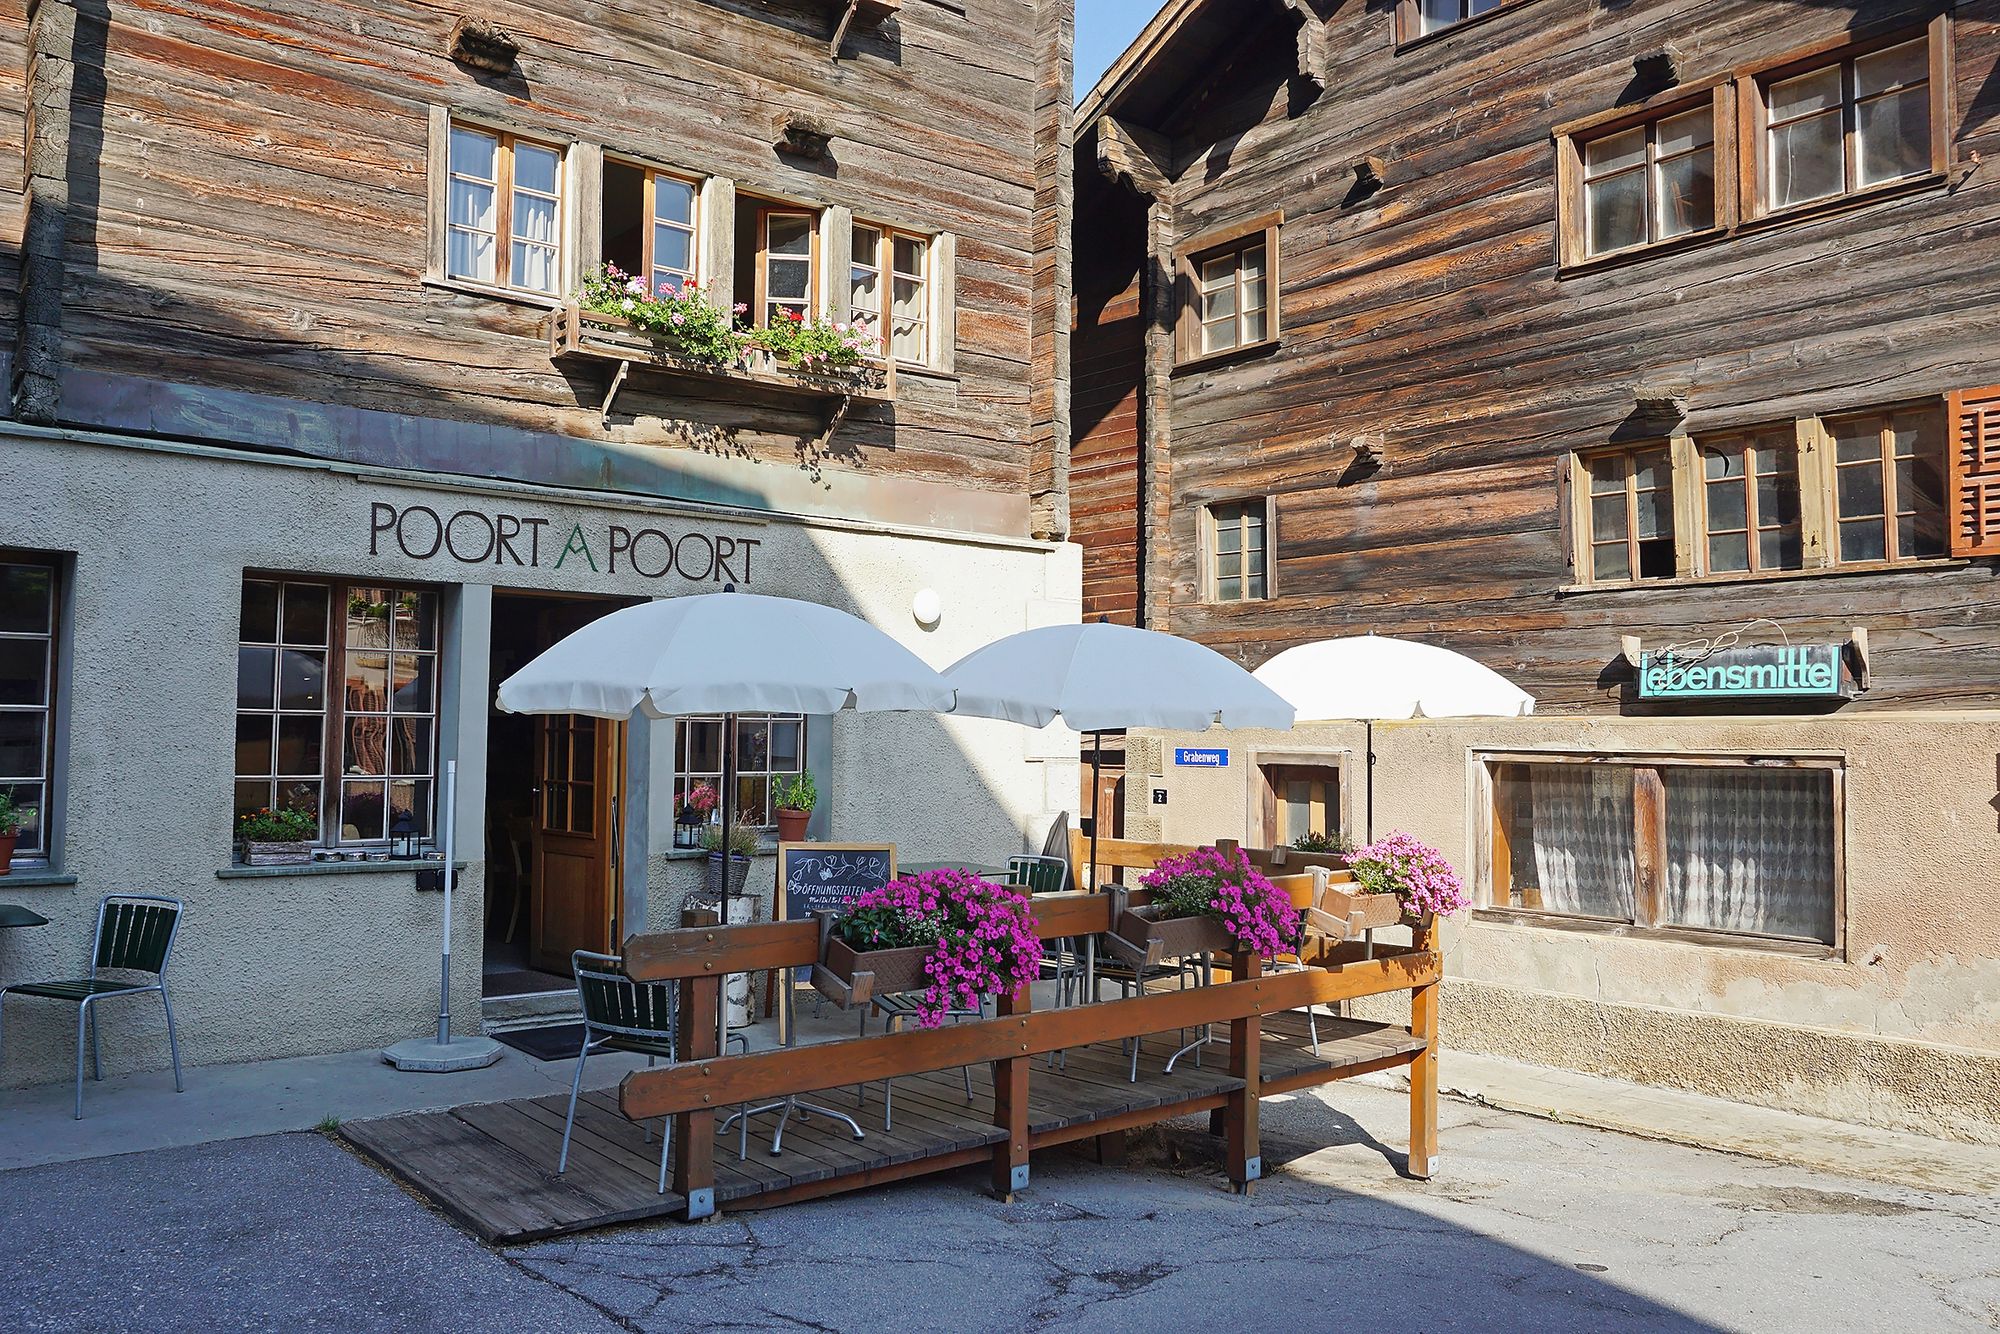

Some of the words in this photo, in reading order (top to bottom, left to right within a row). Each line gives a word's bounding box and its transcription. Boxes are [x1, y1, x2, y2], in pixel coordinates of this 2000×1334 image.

[369, 502, 549, 568] POORT
[554, 523, 598, 572] A
[609, 526, 761, 584] POORT
[1183, 751, 1219, 766] Grabenweg
[802, 883, 867, 896] ÖFFNUNGSZEITEN
